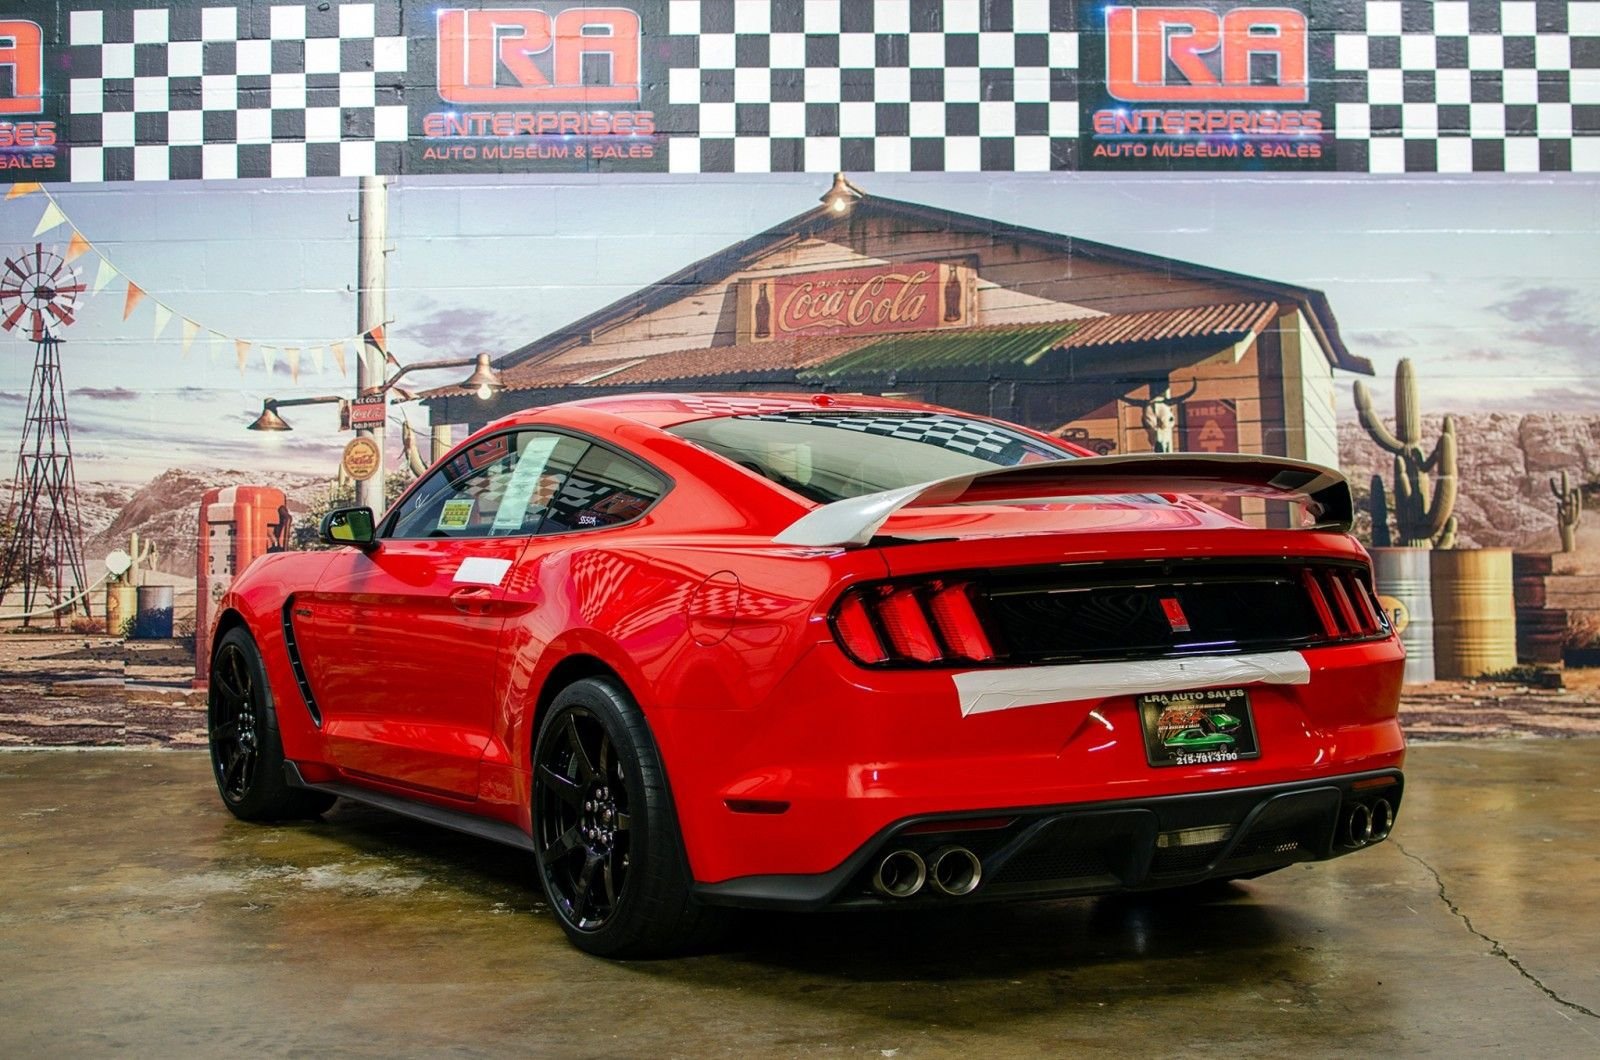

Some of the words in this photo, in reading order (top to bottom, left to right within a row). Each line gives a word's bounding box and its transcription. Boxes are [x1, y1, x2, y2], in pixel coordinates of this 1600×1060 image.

[437, 8, 641, 103] LRA
[1105, 7, 1309, 102] LRA
[423, 111, 655, 136] ENTERPRISES
[1093, 109, 1323, 134] ENTERPRISES
[423, 147, 476, 160] AUTO
[483, 146, 568, 159] MUSEUM
[574, 146, 586, 159] &
[592, 145, 654, 158] SALES
[1093, 144, 1147, 157] AUTO
[1153, 144, 1238, 157] MUSEUM
[1243, 144, 1255, 157] &
[1260, 144, 1322, 157] SALES
[1188, 406, 1226, 416] TIRES
[1145, 695, 1168, 703] LRA
[1172, 692, 1204, 701] AUTO
[1207, 689, 1244, 698] SALES
[1176, 752, 1238, 765] 215-781-3790
